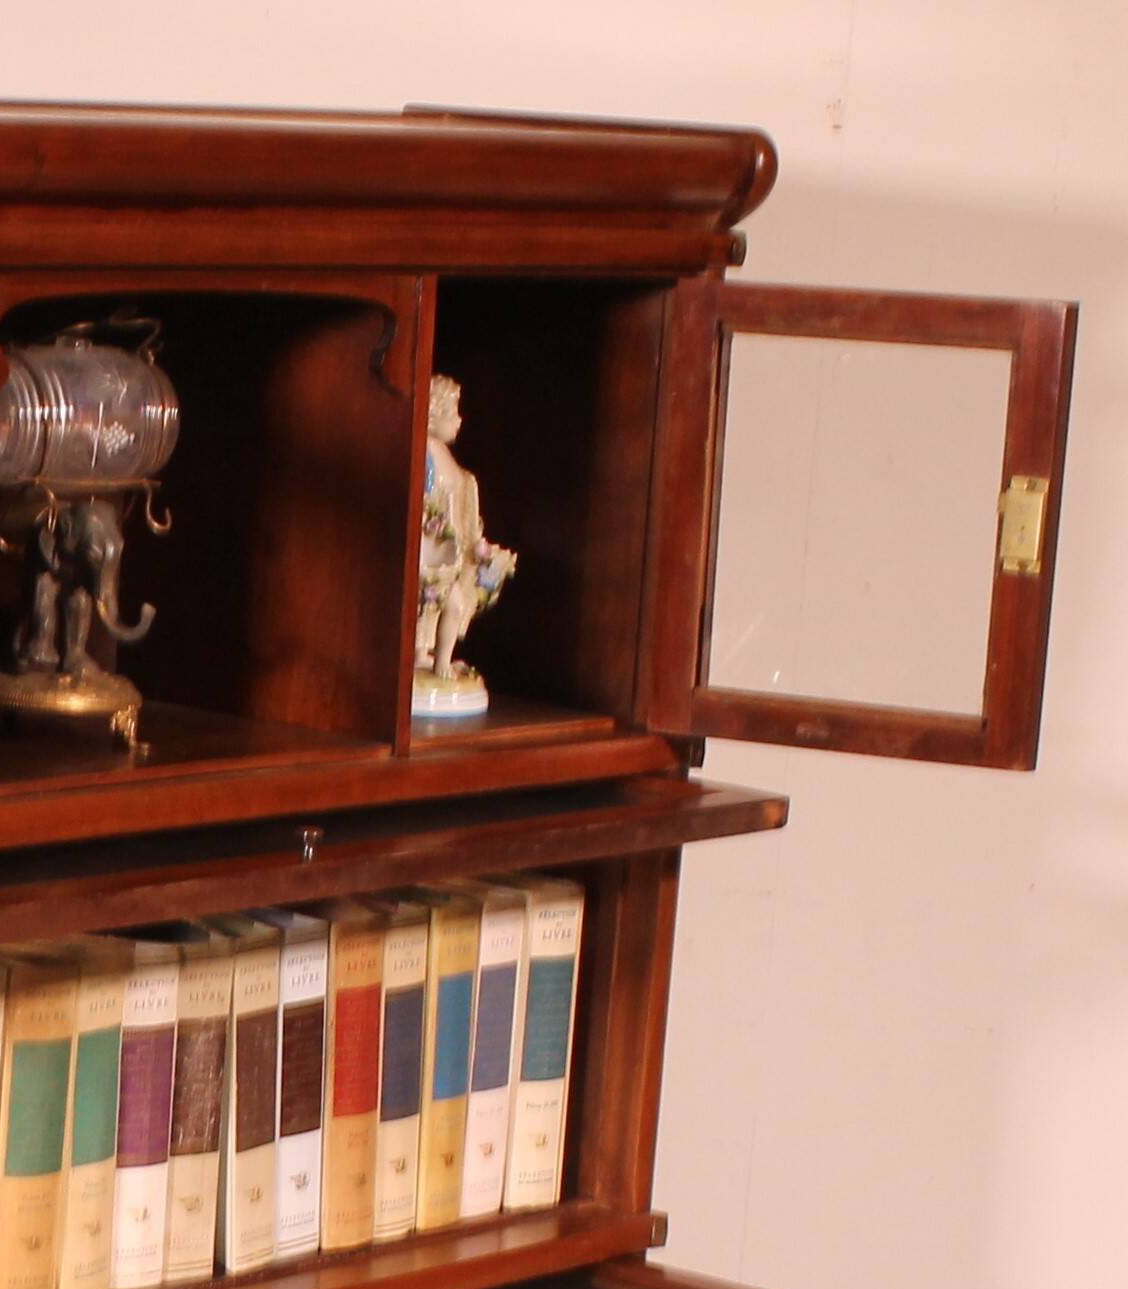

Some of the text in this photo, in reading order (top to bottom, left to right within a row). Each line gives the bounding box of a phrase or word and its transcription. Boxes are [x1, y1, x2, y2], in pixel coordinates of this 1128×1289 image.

[541, 926, 573, 942] LIVRE
[291, 973, 321, 988] LIVRE
[134, 996, 169, 1011] LIVRE
